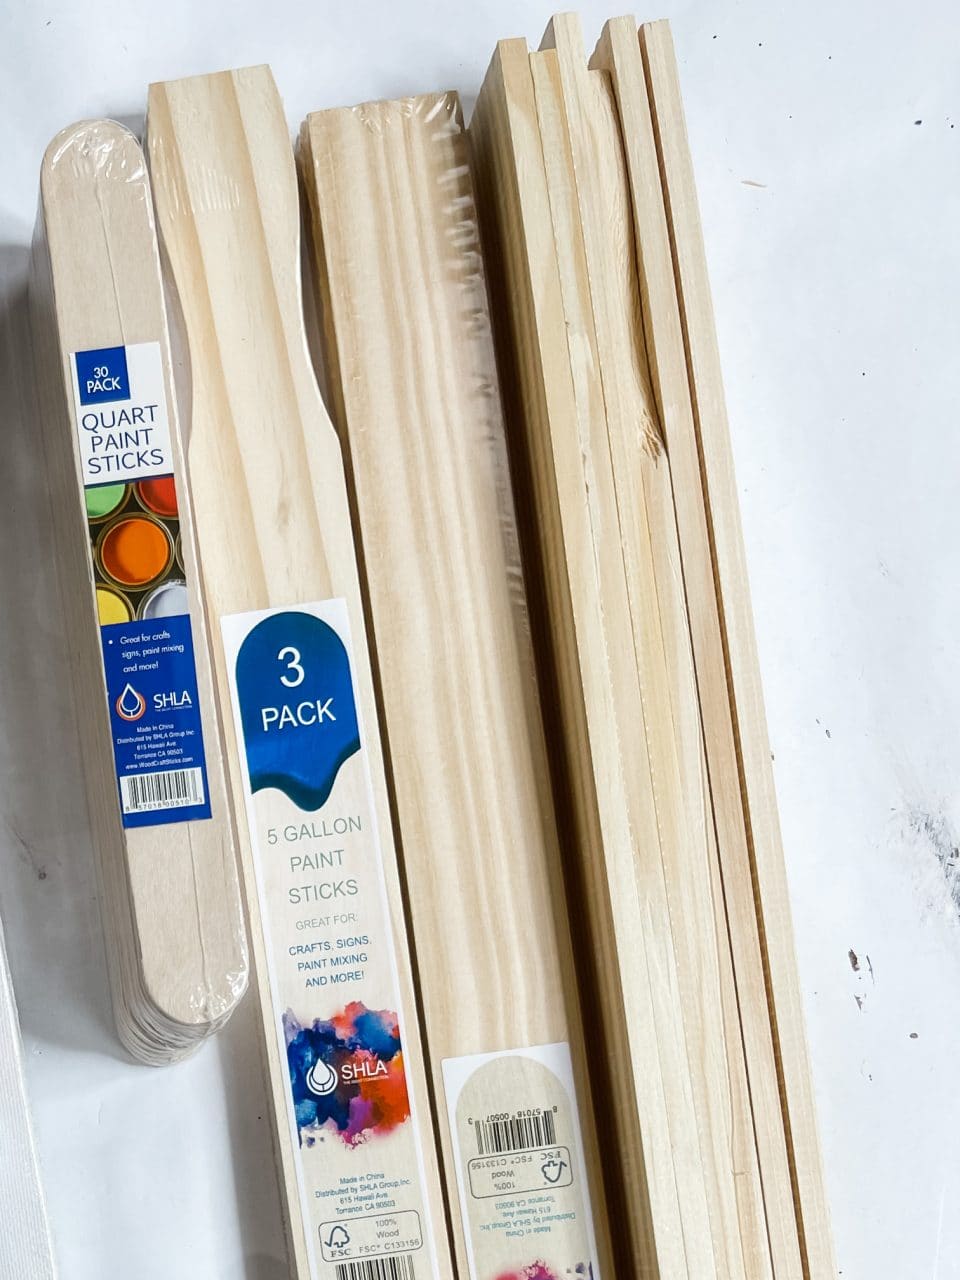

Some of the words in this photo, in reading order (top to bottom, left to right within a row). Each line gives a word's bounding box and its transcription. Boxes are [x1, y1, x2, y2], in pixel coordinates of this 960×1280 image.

[94, 366, 109, 379] 30
[86, 376, 122, 394] PACK
[81, 404, 158, 434] QUART
[91, 428, 153, 453] PAINT
[87, 448, 164, 474] STICKS
[119, 635, 141, 645] Great
[141, 633, 151, 642] for
[152, 630, 171, 640] crafts
[121, 649, 141, 660] signs,
[142, 646, 160, 657] paint
[161, 644, 184, 653] mixing
[123, 663, 137, 673] and
[138, 660, 159, 671] more!
[276, 645, 306, 689] 3
[153, 690, 192, 709] SHLA
[260, 698, 337, 732] PACK
[267, 828, 278, 845] 5
[284, 815, 362, 842] GALLON
[290, 849, 345, 873] PAINT
[288, 879, 359, 904] STICKS
[295, 916, 330, 931] GREAT
[297, 958, 327, 972] PAINT
[330, 952, 368, 967] MIXING
[305, 974, 328, 988] AND
[330, 970, 365, 984] MORE!
[341, 1060, 388, 1080] SHLA
[376, 1229, 400, 1239] Wood
